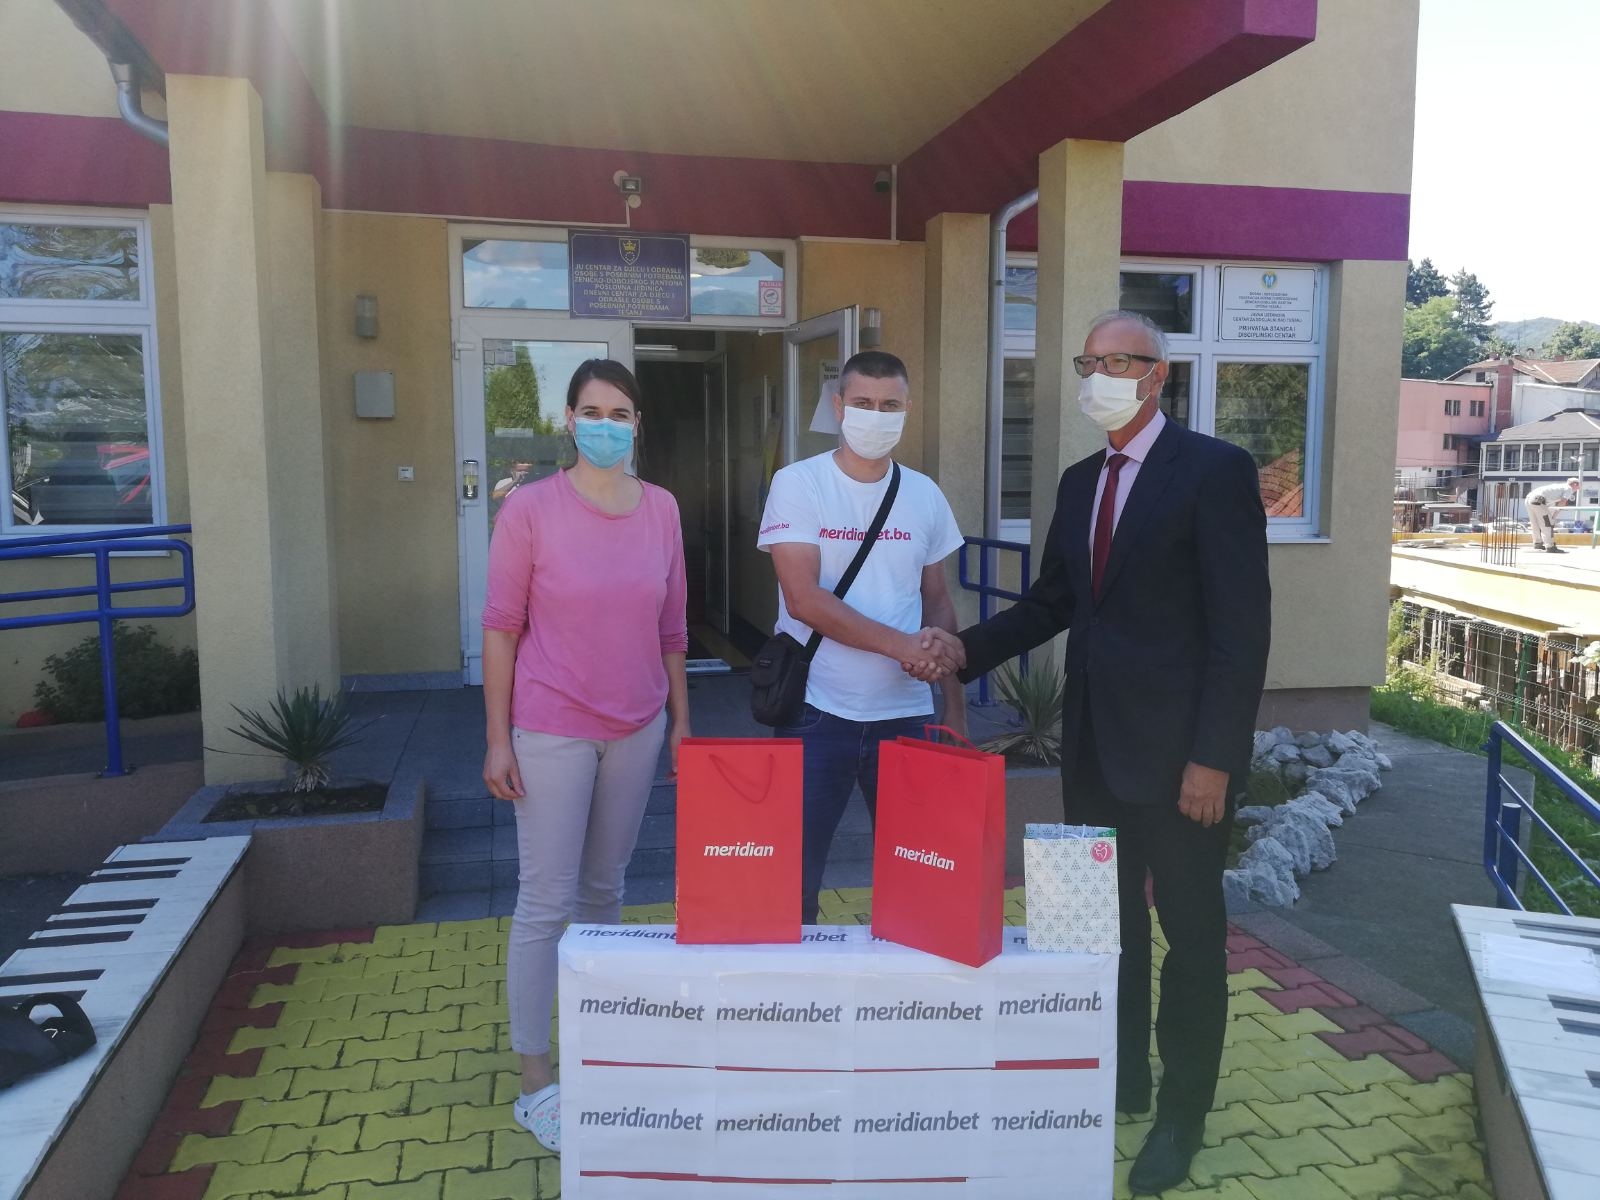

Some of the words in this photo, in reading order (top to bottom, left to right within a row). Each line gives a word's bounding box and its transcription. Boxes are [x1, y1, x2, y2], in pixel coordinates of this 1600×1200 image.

[574, 270, 597, 278] OSOBE
[643, 273, 685, 281] POTREBAMA
[650, 279, 683, 287] KANTONA
[611, 290, 637, 298] CENTAR
[627, 304, 669, 312] POTREBAMA
[819, 526, 911, 542] meridiaet.ba
[703, 841, 774, 857] meridian
[894, 845, 955, 871] meridian
[579, 996, 705, 1022] meridianbet
[716, 1002, 842, 1023] meridianbet
[856, 1000, 983, 1021] meridianbet
[999, 991, 1102, 1016] meridianb
[580, 1106, 704, 1131] meridianbet
[716, 1112, 842, 1133] meridianbet
[854, 1110, 980, 1134] meridianbet
